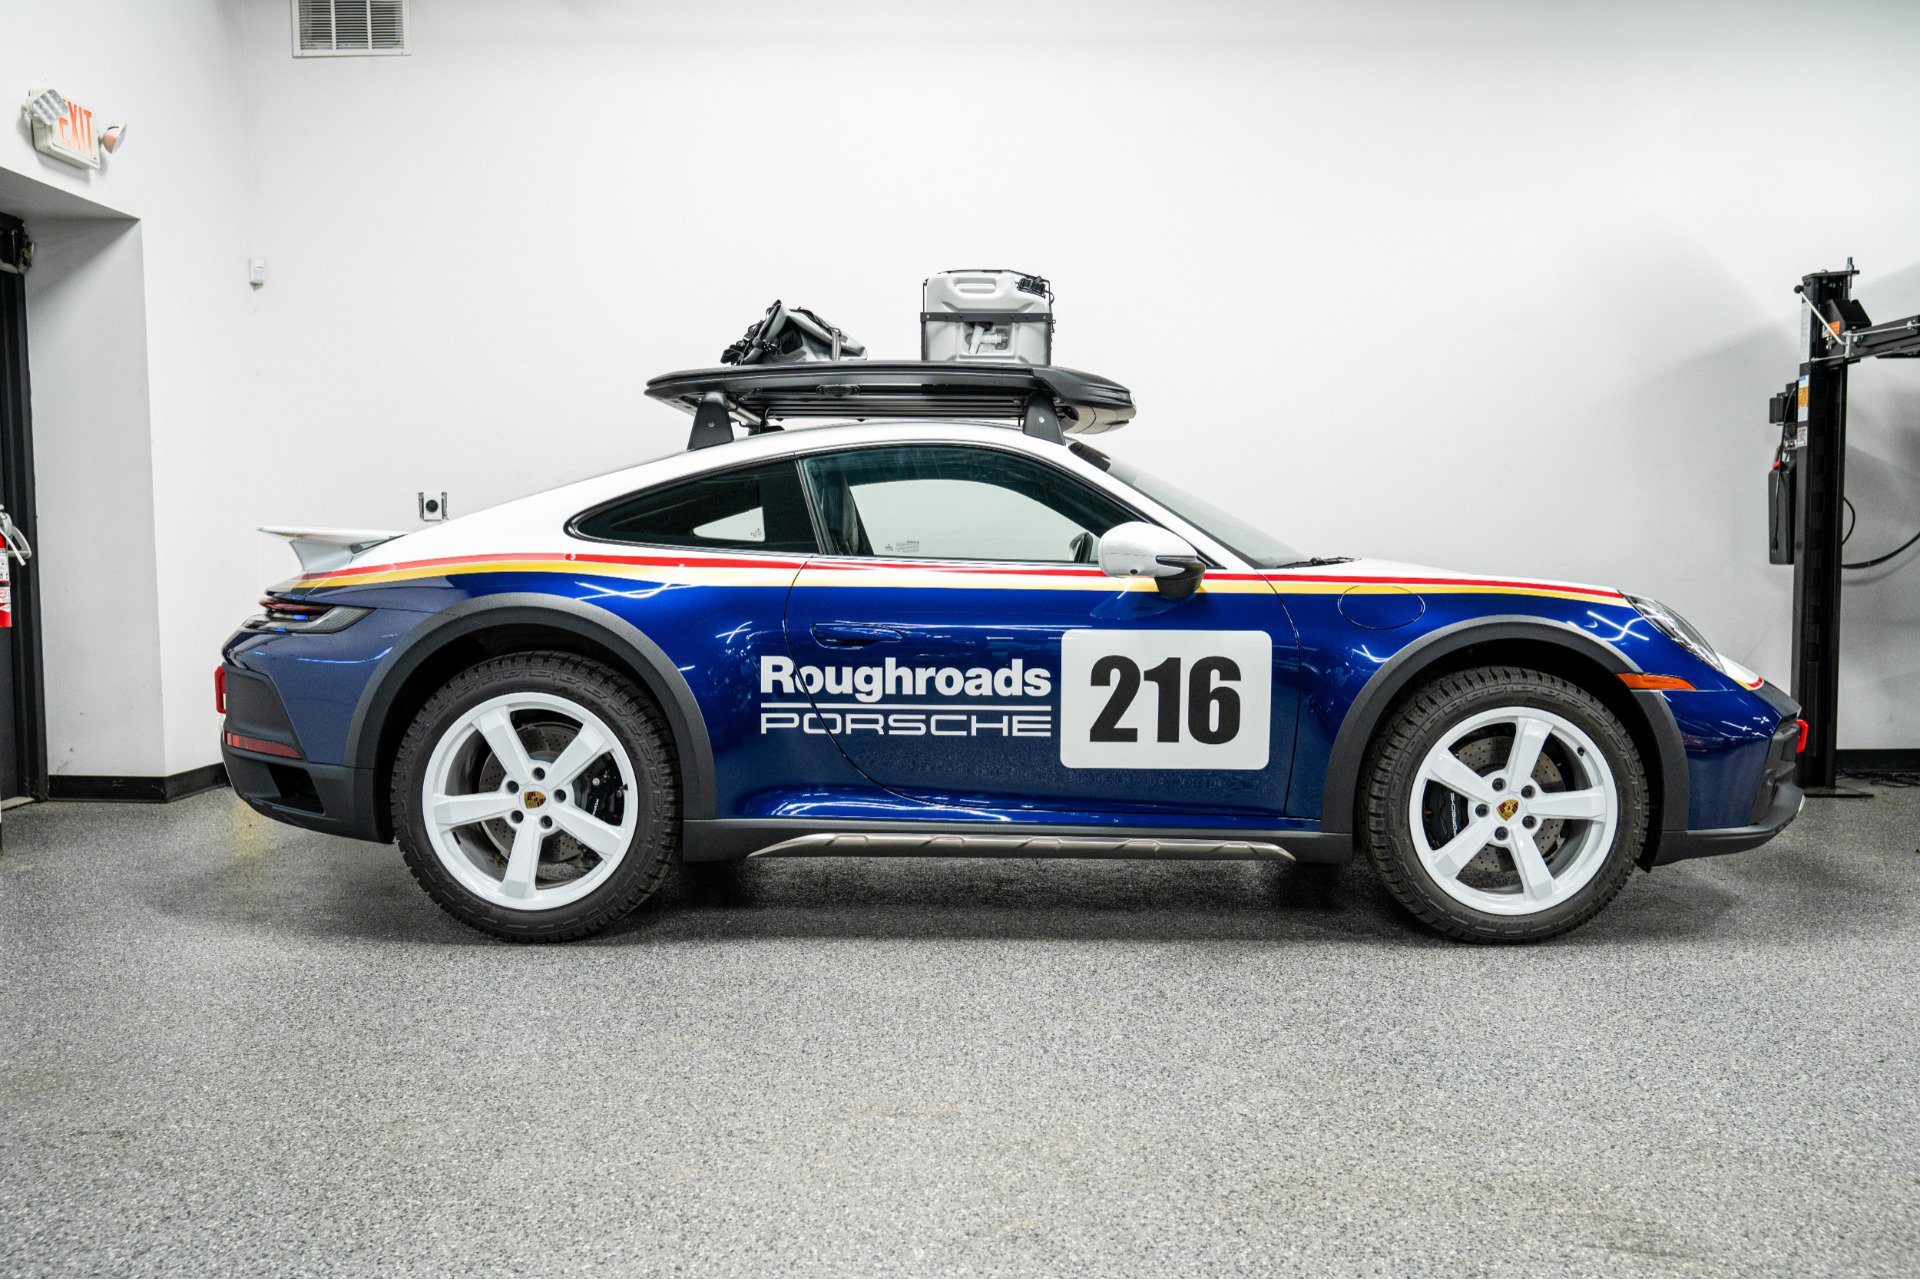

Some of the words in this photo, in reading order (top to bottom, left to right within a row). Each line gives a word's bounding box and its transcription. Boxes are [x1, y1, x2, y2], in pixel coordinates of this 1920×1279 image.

[760, 655, 1052, 703] Roughroads
[1089, 654, 1242, 745] 216
[760, 712, 1052, 737] PORSCHE
